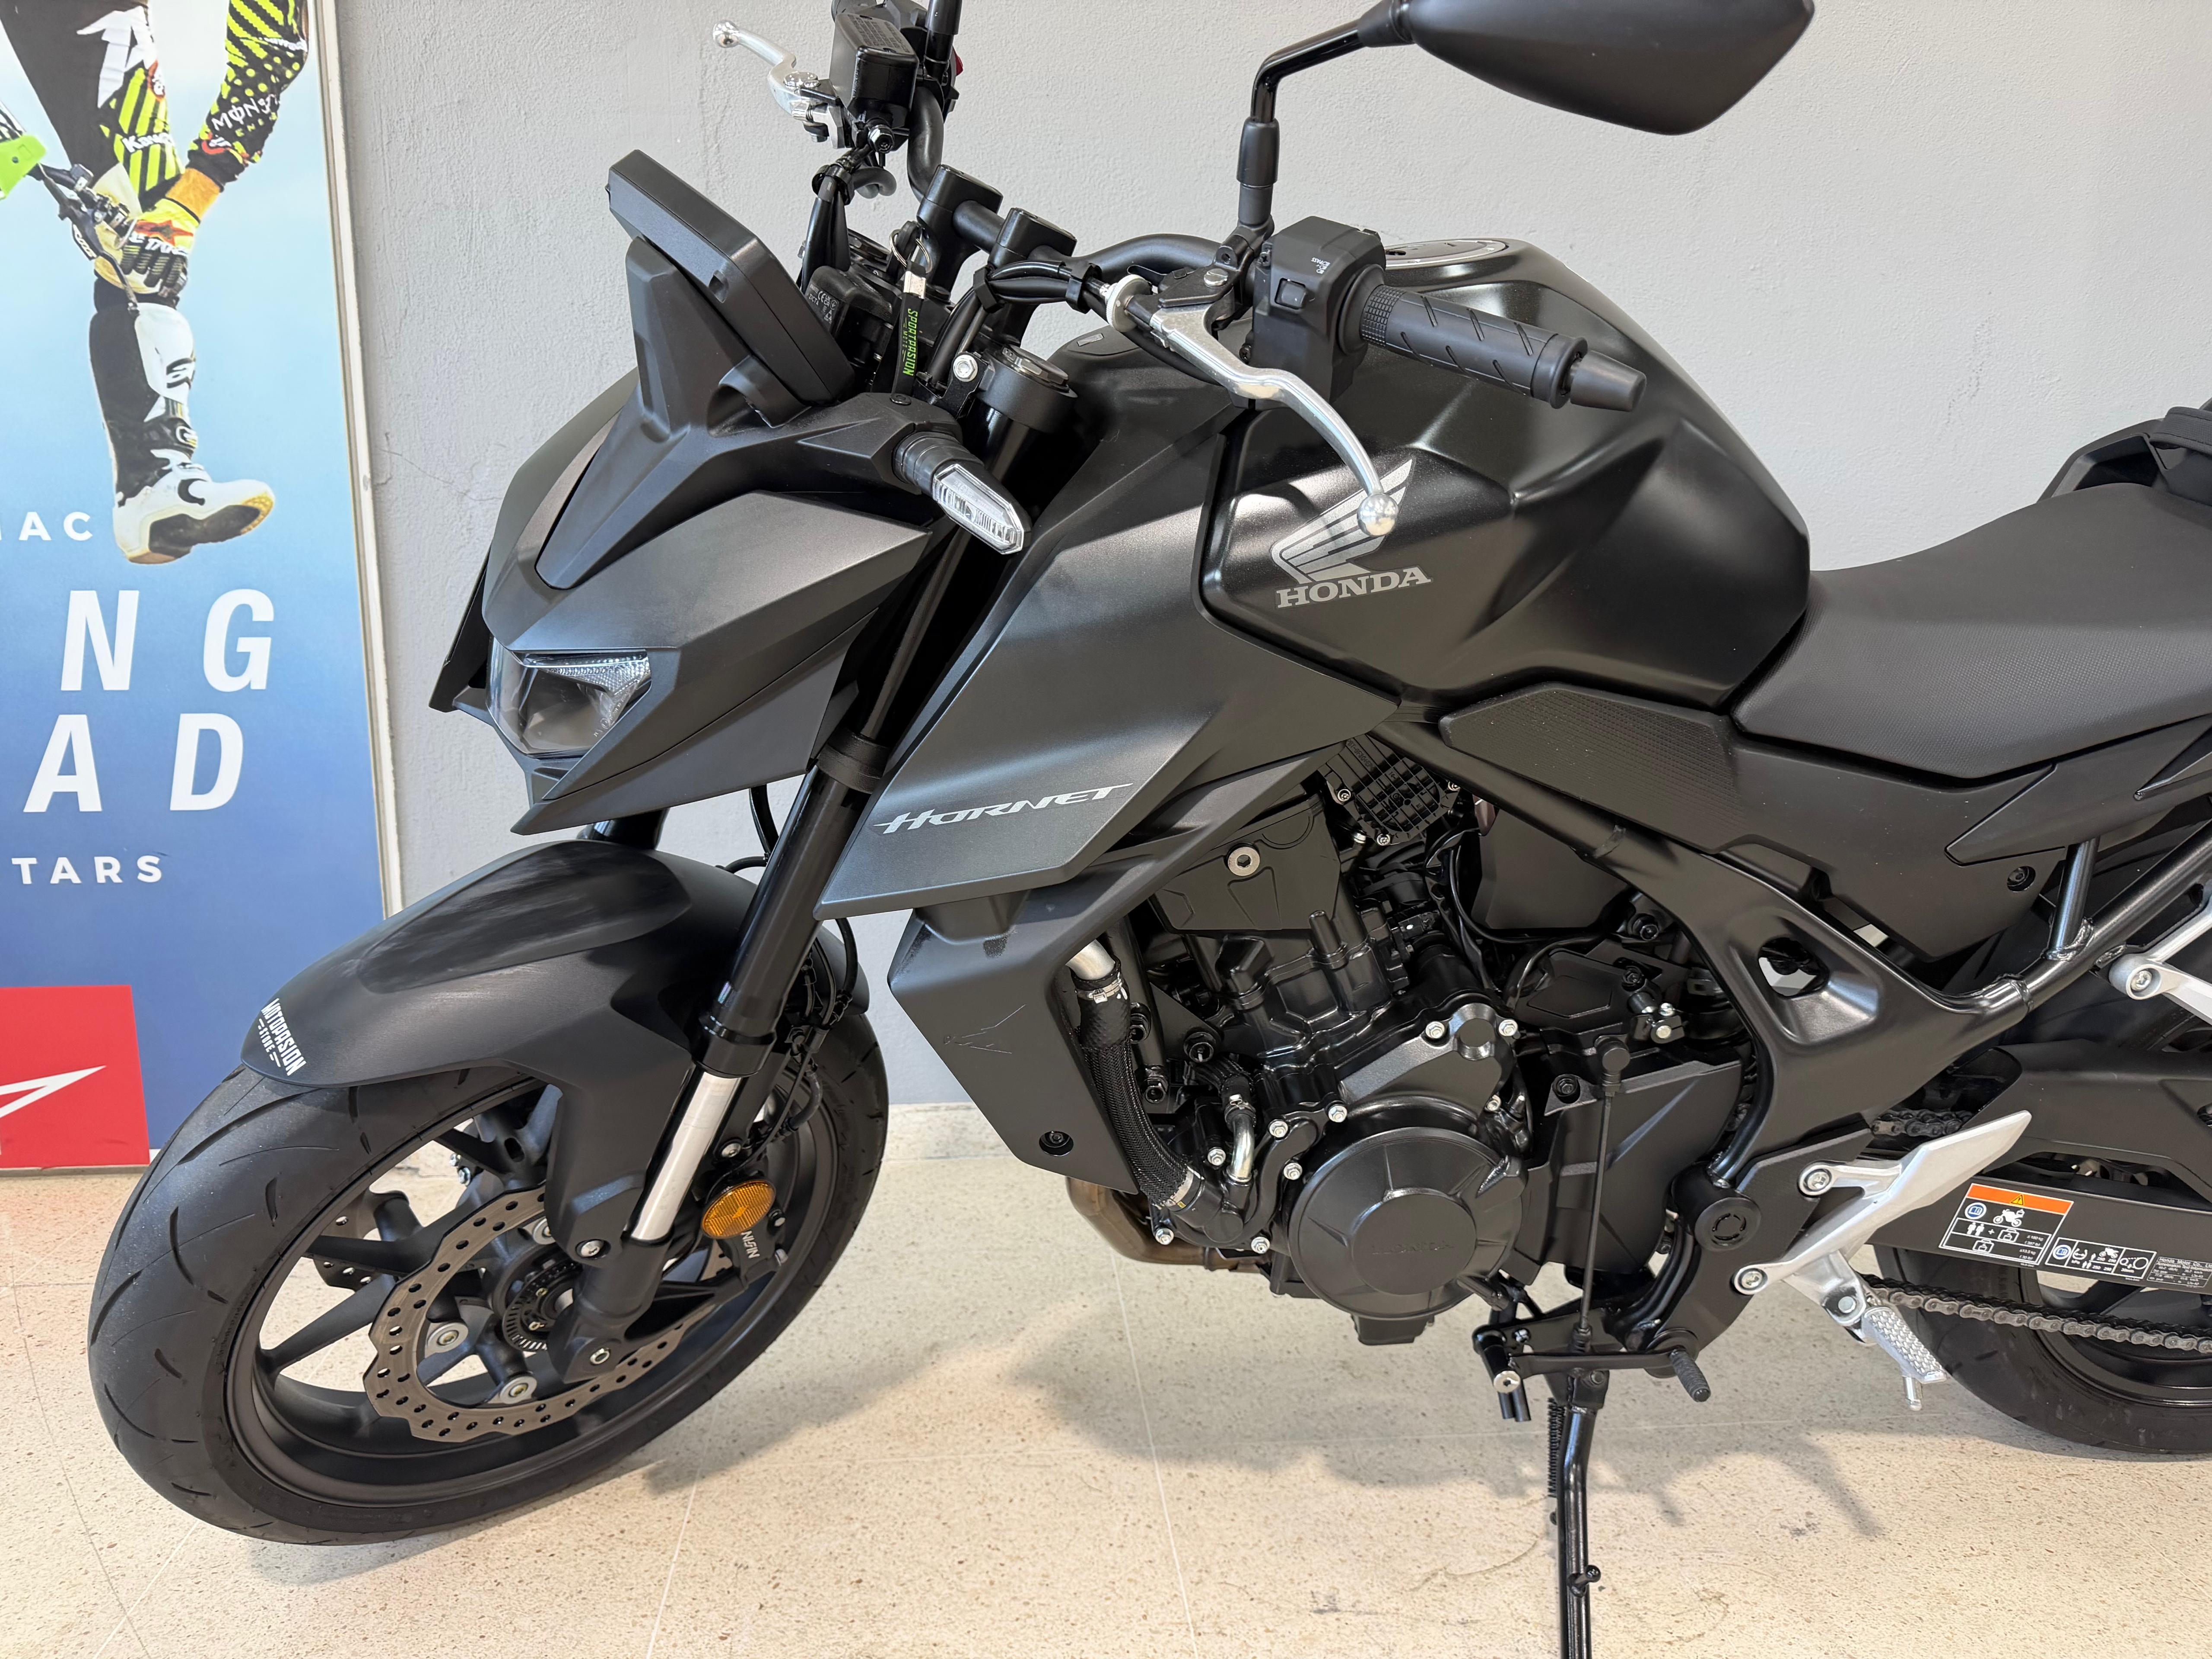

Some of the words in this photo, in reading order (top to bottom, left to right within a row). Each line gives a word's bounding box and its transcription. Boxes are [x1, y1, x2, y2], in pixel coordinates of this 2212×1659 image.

[903, 308, 918, 376] SPORTPASION
[0, 512, 92, 541] AC
[1276, 566, 1431, 608] HONDA
[873, 782, 1133, 834] HORNET
[11, 855, 163, 884] TARS
[259, 1027, 275, 1052] STORE
[261, 998, 307, 1076] MOTOPASION
